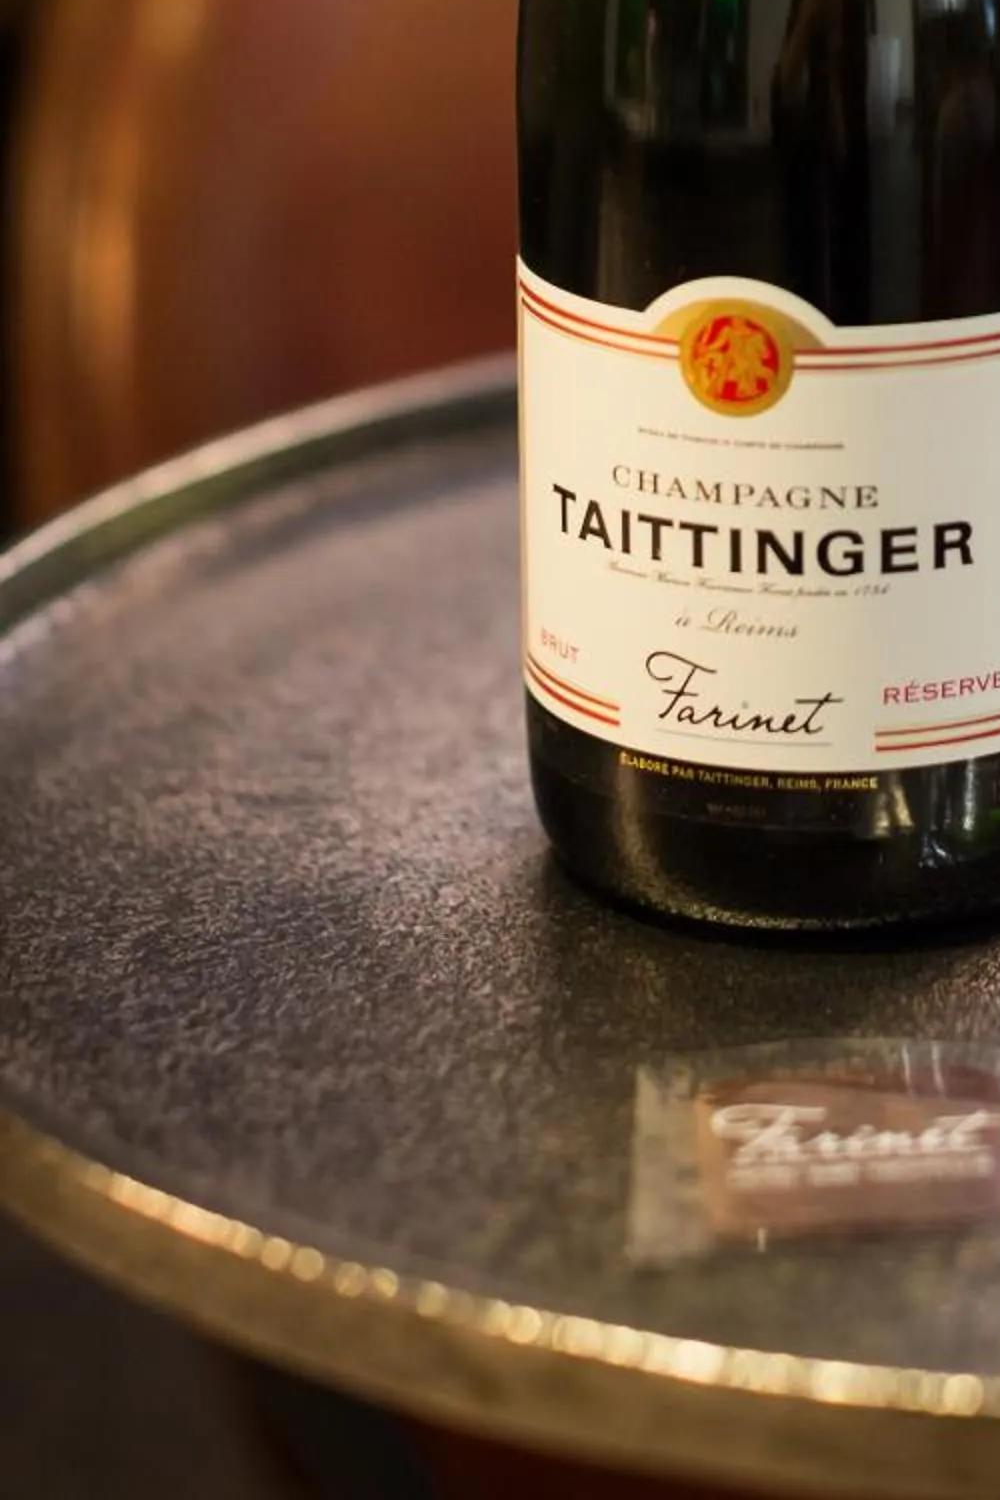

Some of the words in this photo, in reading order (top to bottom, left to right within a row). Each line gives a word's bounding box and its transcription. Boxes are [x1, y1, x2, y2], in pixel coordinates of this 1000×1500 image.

[612, 464, 879, 509] CHAMPAGNE
[553, 483, 975, 576] TAITTINGER
[698, 607, 799, 639] Reims
[541, 626, 581, 663] BRUT
[645, 651, 844, 734] Farinet
[825, 776, 879, 791] FRANCE
